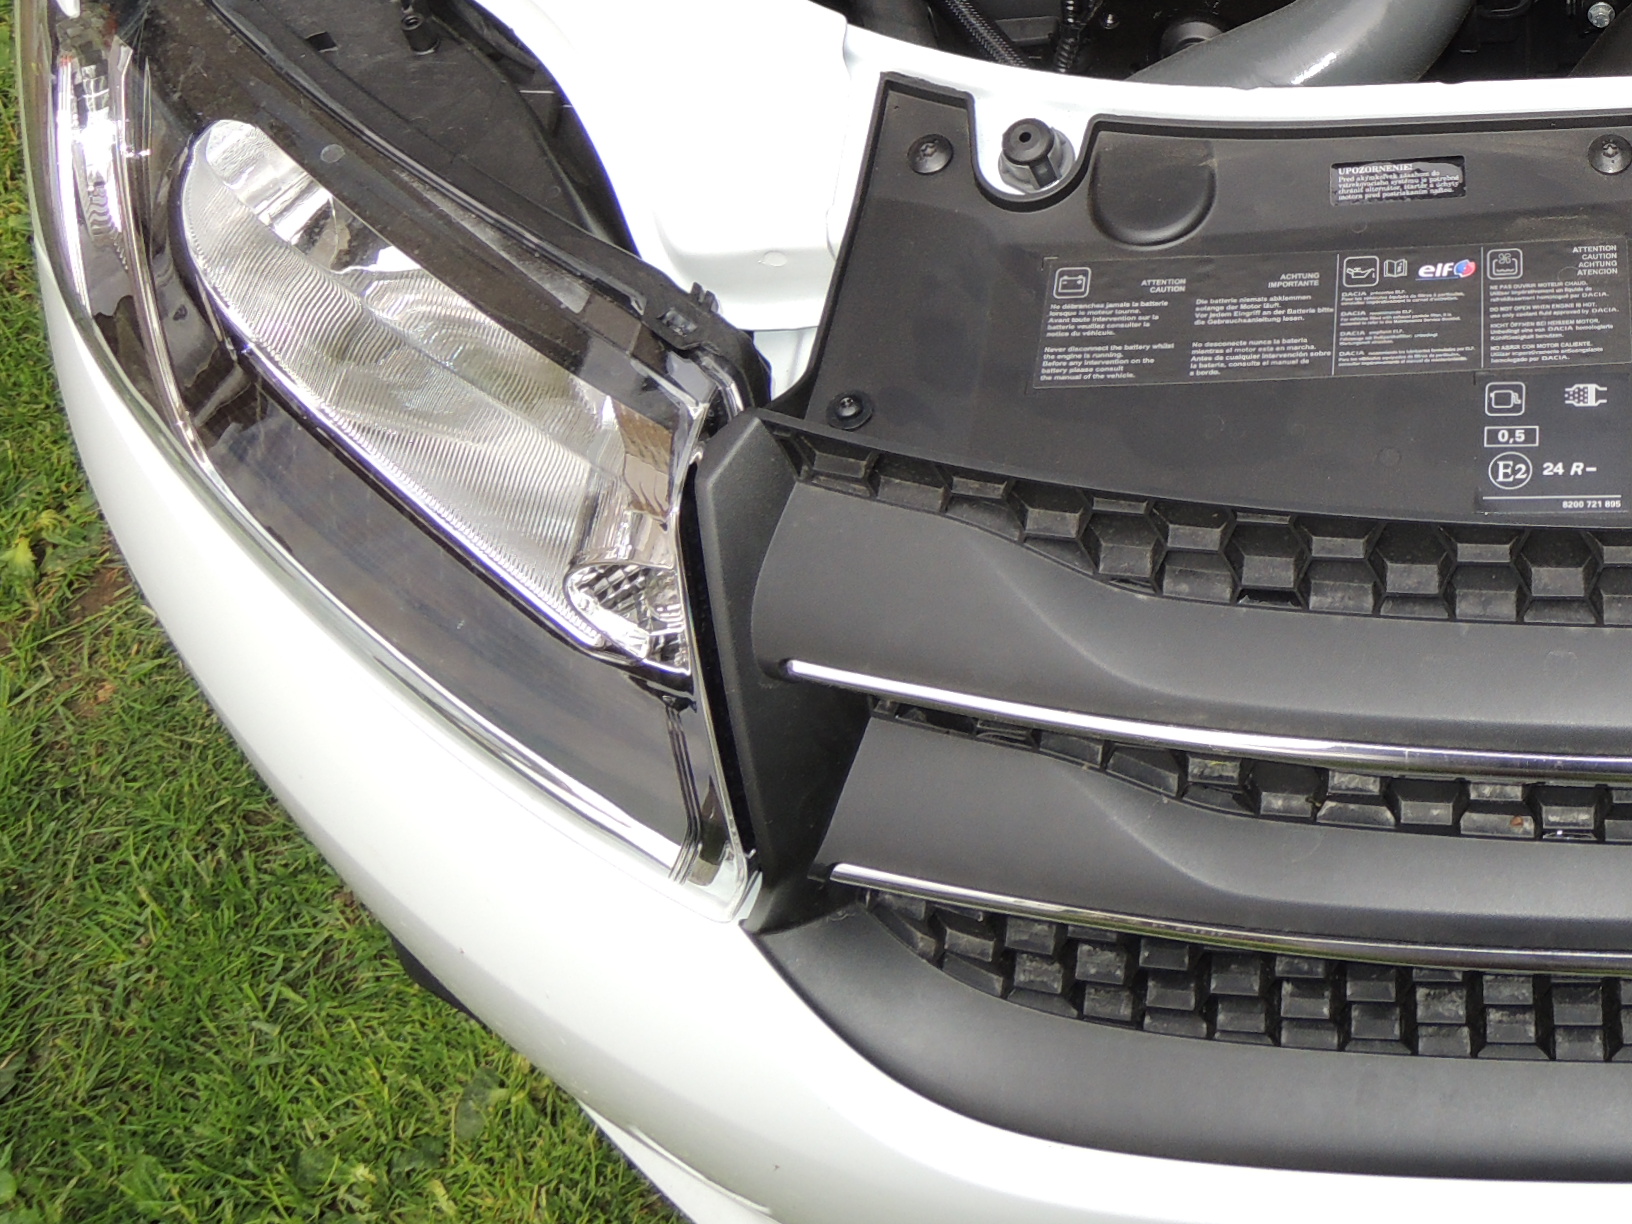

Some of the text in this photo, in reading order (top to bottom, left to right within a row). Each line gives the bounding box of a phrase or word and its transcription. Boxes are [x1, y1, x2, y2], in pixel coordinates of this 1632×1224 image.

[1338, 164, 1413, 175] UPOZORNENIE!
[1572, 245, 1617, 253] ATTENTION
[1578, 260, 1618, 268] ACHTUNG
[1418, 262, 1454, 277] elf
[1577, 268, 1618, 276] ATENCION
[1280, 272, 1320, 280] ACHTUNG
[1141, 278, 1186, 286] ATTENTION
[1268, 280, 1319, 288] IMPORTANTE
[1225, 353, 1260, 361] cualquier
[1498, 430, 1525, 444] 0,5
[1496, 461, 1528, 482] E2
[1542, 462, 1565, 476] 24
[1562, 500, 1584, 508] 8200
[1587, 500, 1602, 508] 721
